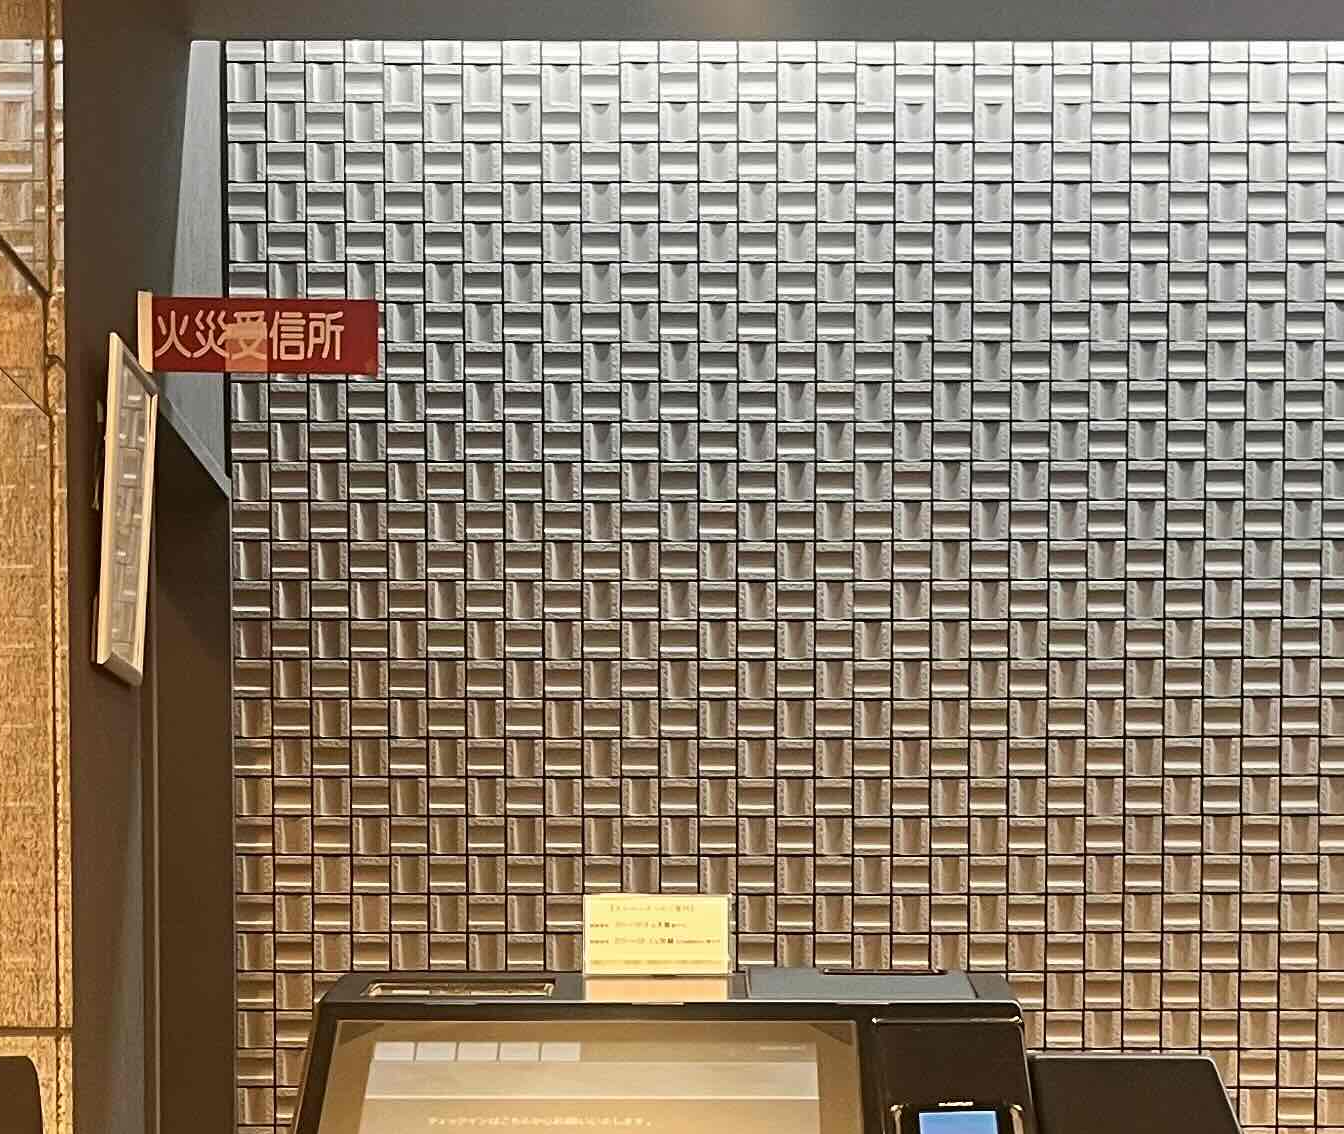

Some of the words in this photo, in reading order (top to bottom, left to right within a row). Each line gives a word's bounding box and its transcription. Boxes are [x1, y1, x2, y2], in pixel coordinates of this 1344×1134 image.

[155, 310, 345, 362] 火災受信所
